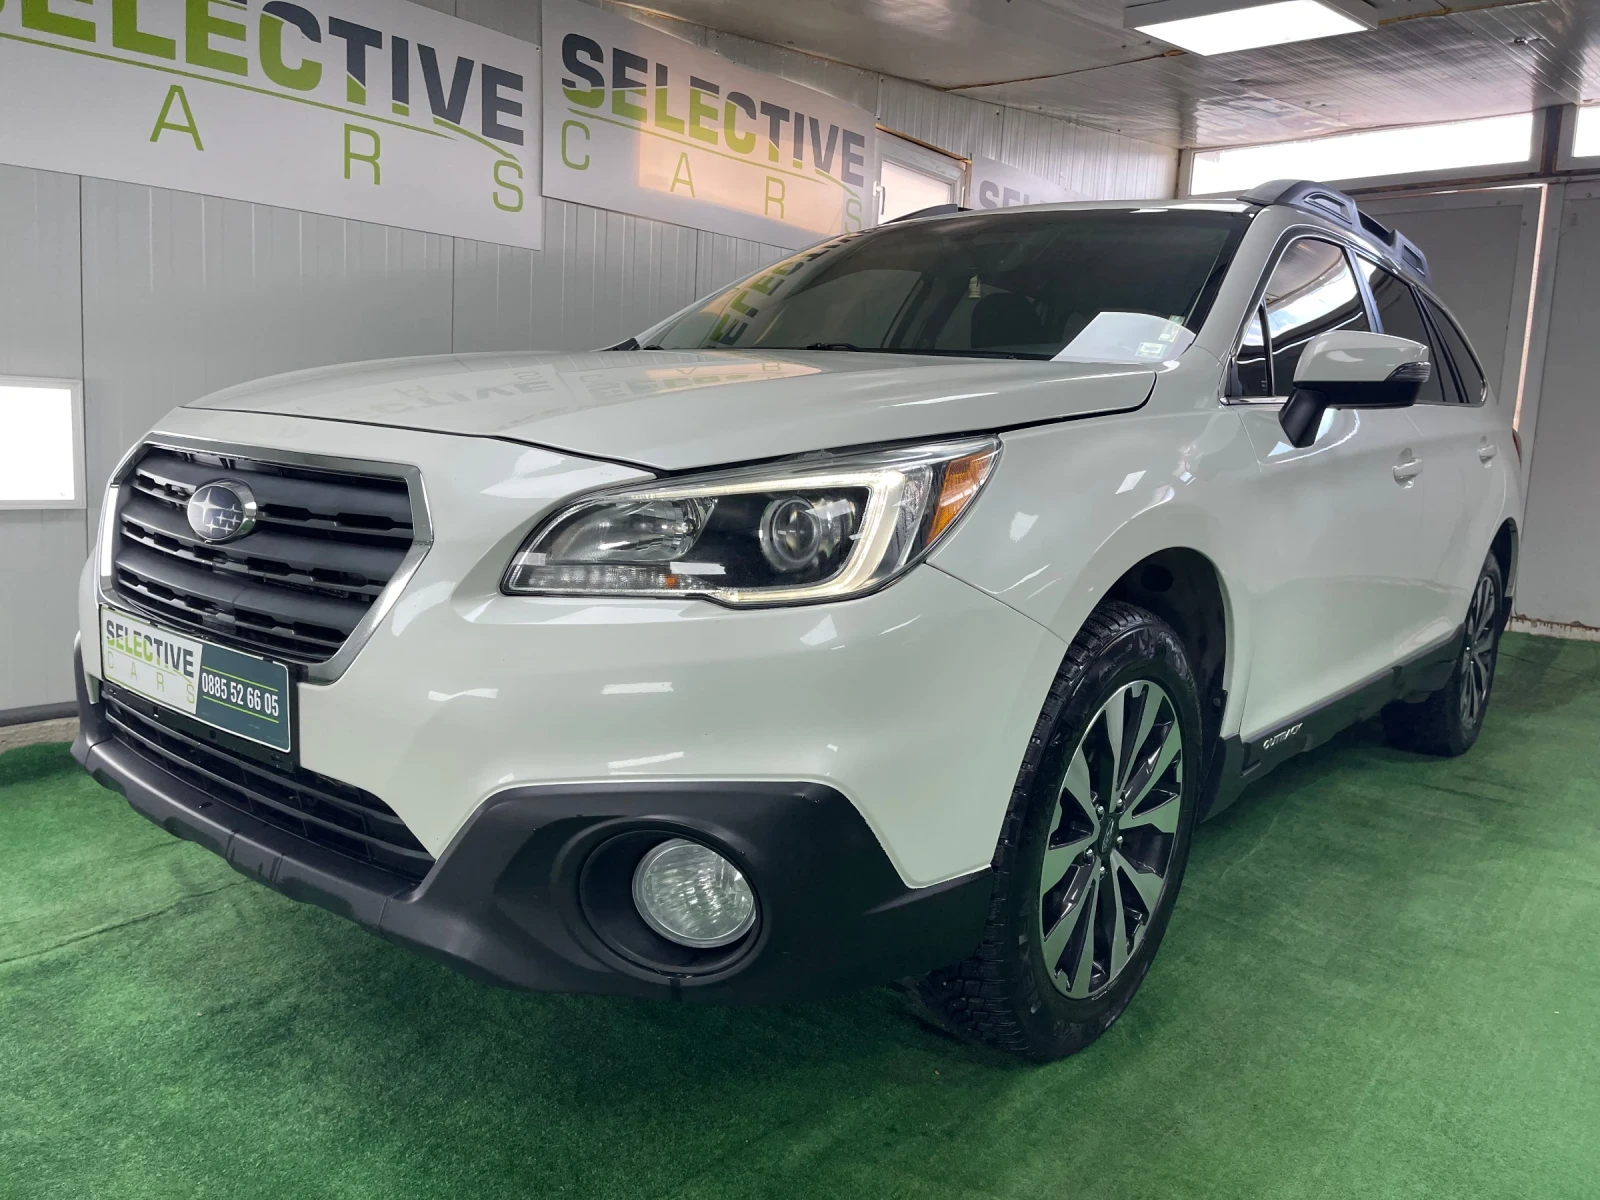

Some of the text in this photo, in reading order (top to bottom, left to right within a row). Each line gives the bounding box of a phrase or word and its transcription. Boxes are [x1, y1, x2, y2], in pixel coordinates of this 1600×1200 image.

[0, 0, 524, 146] LECTIVE
[561, 33, 865, 188] SELECTIVE
[150, 84, 524, 213] ARS
[106, 619, 194, 679] SELECTIVE
[107, 650, 195, 704] CARS
[202, 672, 279, 716] 0885 52 66 05
